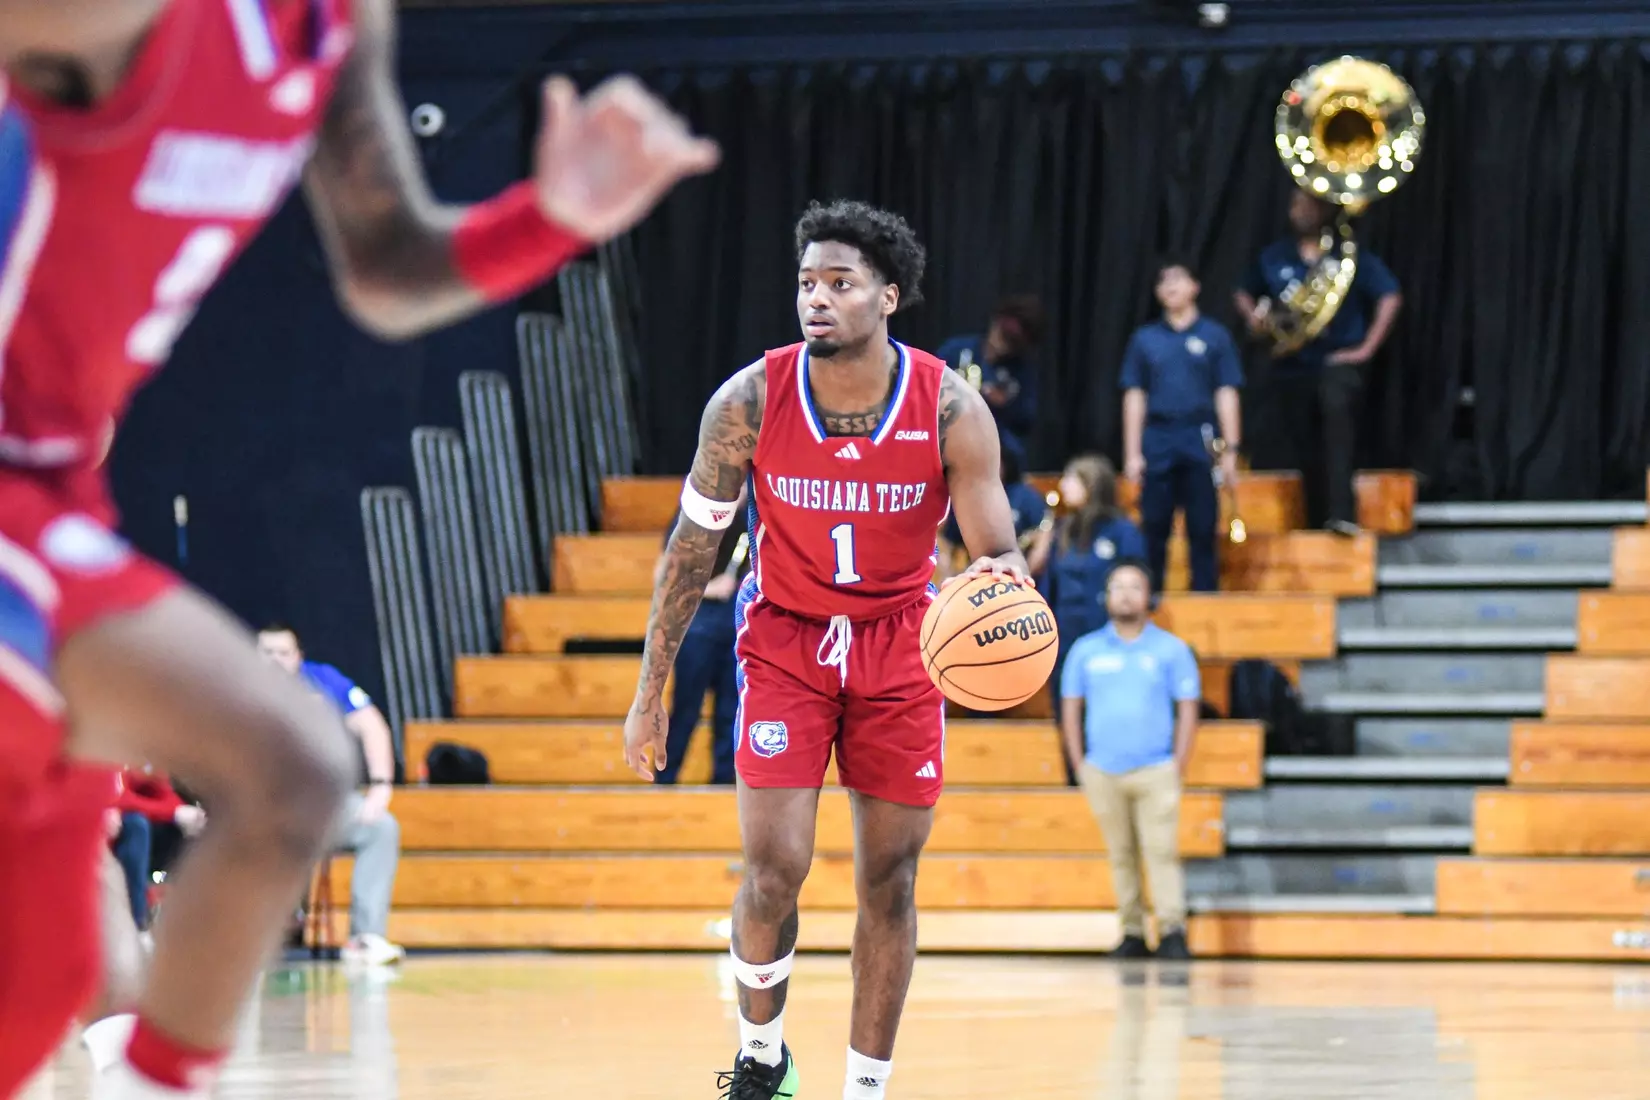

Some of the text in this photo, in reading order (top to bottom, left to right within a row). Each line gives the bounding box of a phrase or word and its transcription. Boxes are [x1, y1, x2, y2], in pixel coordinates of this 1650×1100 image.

[766, 473, 927, 513] LOUISIANA TECH
[829, 523, 862, 585] 1
[973, 610, 1053, 647] Wilson
